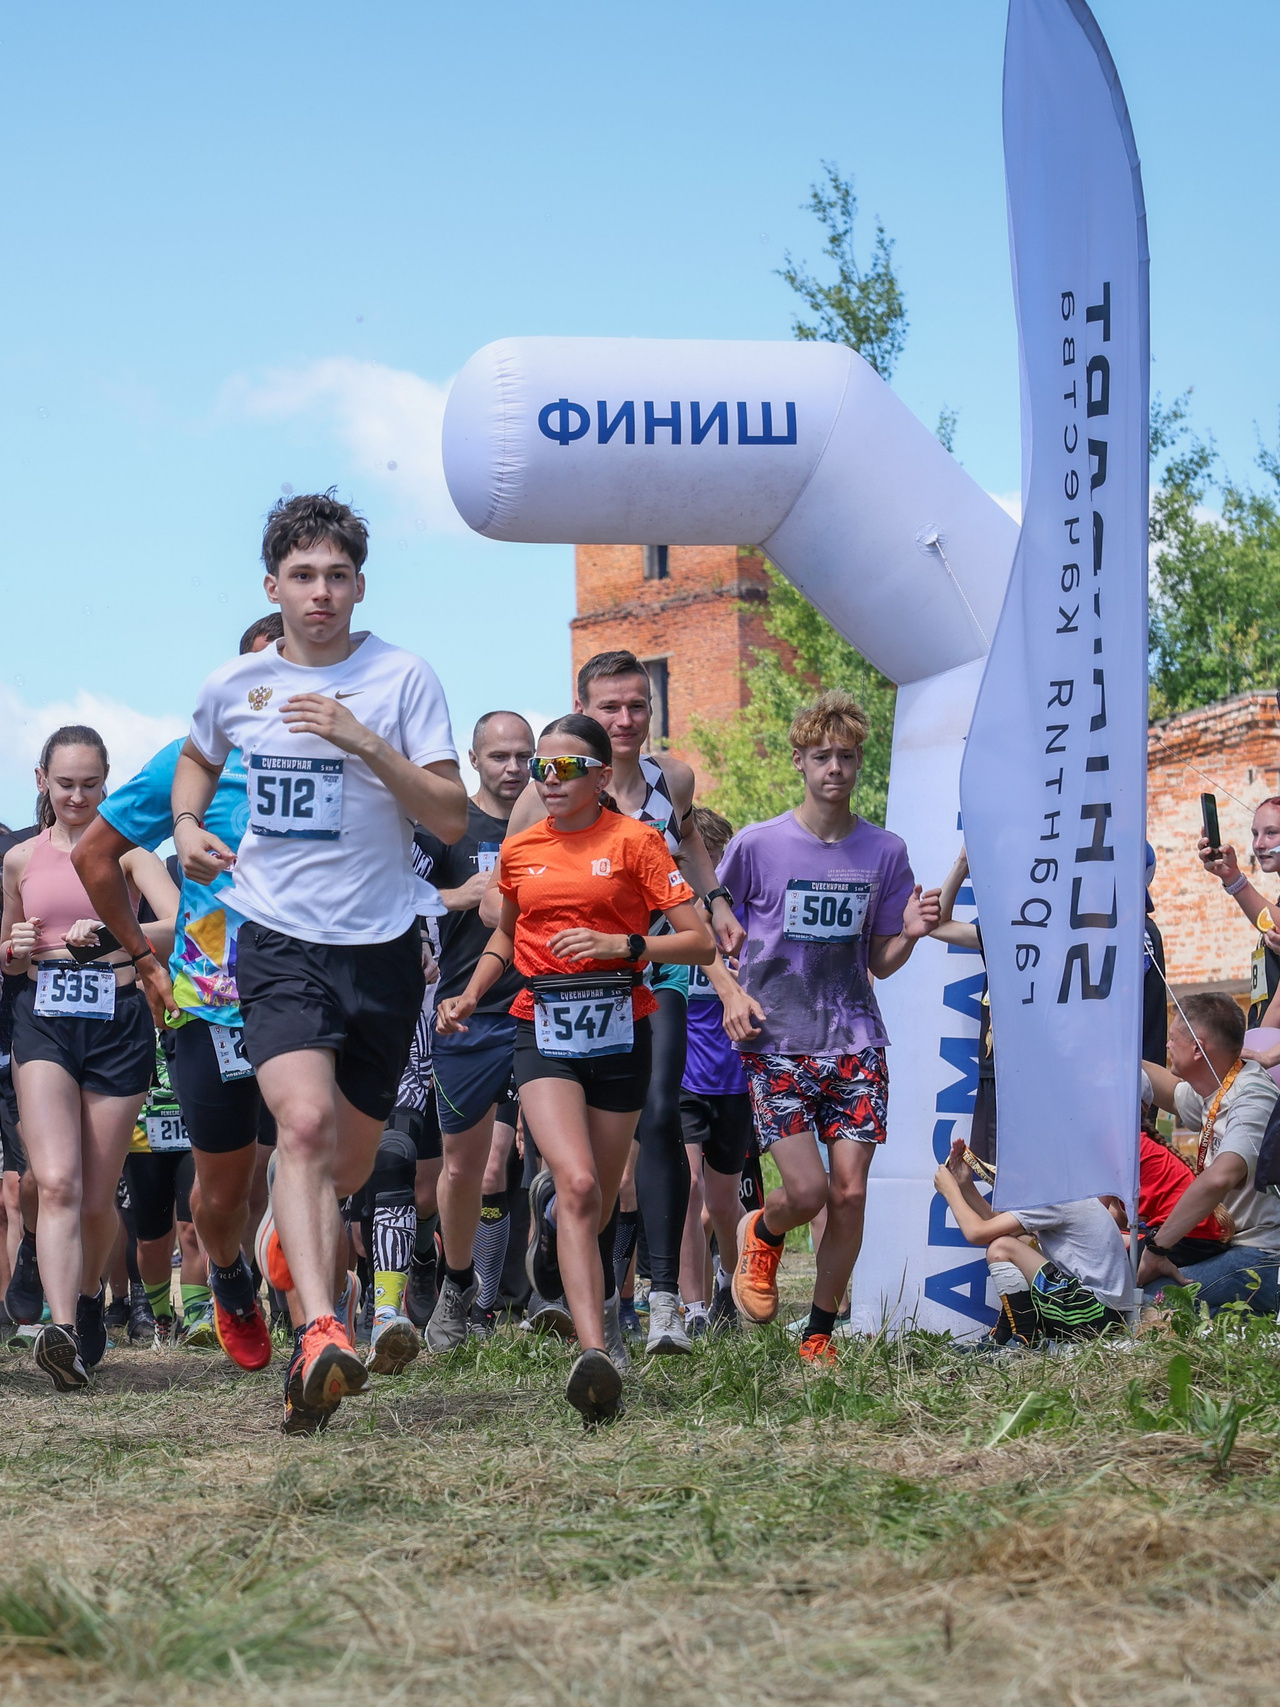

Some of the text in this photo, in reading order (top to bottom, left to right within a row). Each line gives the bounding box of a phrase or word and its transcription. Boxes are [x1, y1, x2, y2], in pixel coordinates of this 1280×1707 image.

[538, 398, 797, 445] ФИНИШ
[261, 757, 312, 770] СУВЕНИРНАЯ
[257, 775, 315, 818] 512
[802, 896, 853, 927] 506
[51, 974, 99, 1004] 535
[560, 989, 604, 1001] СУВЕНИРНАЯ
[553, 1002, 614, 1040] 547
